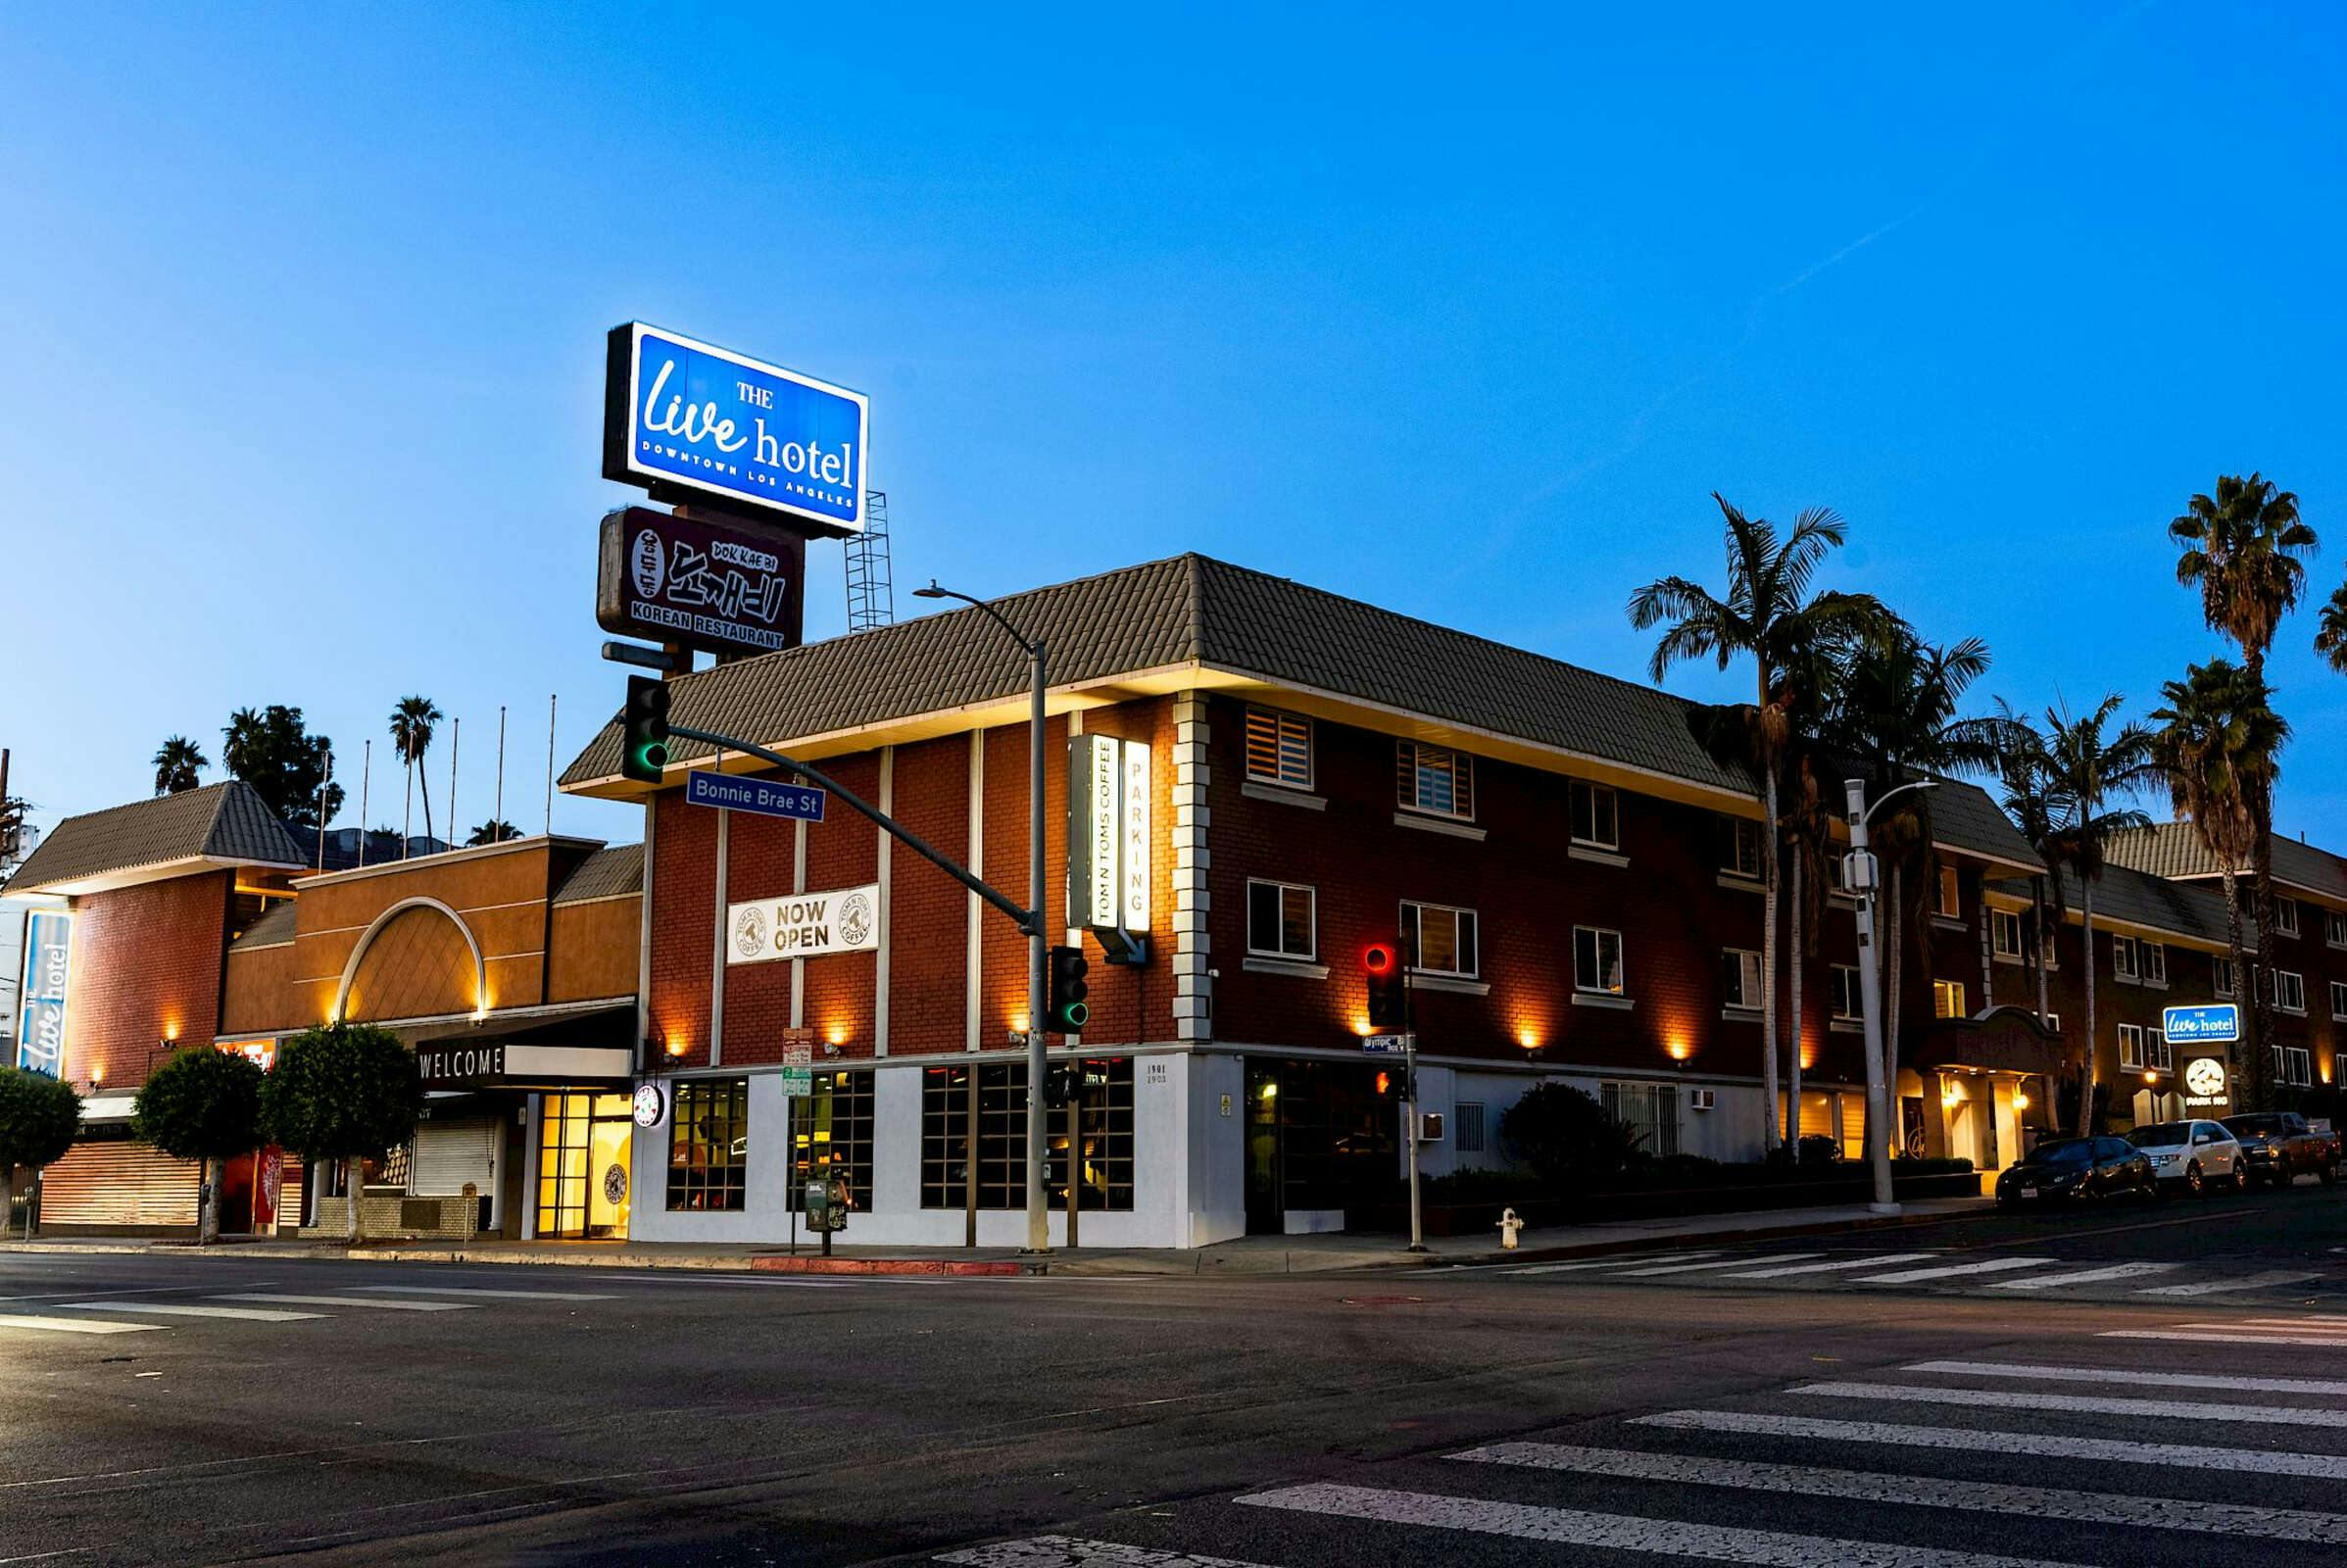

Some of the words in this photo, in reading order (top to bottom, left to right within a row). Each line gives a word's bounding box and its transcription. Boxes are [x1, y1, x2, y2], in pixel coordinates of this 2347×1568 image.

[737, 381, 773, 410] THE
[753, 417, 853, 489] hotel
[642, 440, 737, 477] DOWNTOWN
[748, 470, 775, 486] LOS
[786, 482, 853, 508] ANGELES
[632, 602, 691, 628] KOREAN
[695, 616, 784, 648] RESTAURANT
[1100, 742, 1110, 808] COFFEE
[696, 779, 752, 803] Bonnie
[758, 789, 794, 809] Brae
[800, 796, 816, 812] St
[1100, 813, 1110, 861] TOMS
[1131, 763, 1143, 911] PARKING
[1100, 867, 1109, 878] N
[777, 901, 826, 926] NOW
[1099, 884, 1110, 920] TOM
[774, 925, 829, 951] OPEN
[41, 944, 67, 1001] hotel
[2201, 1017, 2233, 1032] hotel
[419, 1048, 501, 1078] WELCOME
